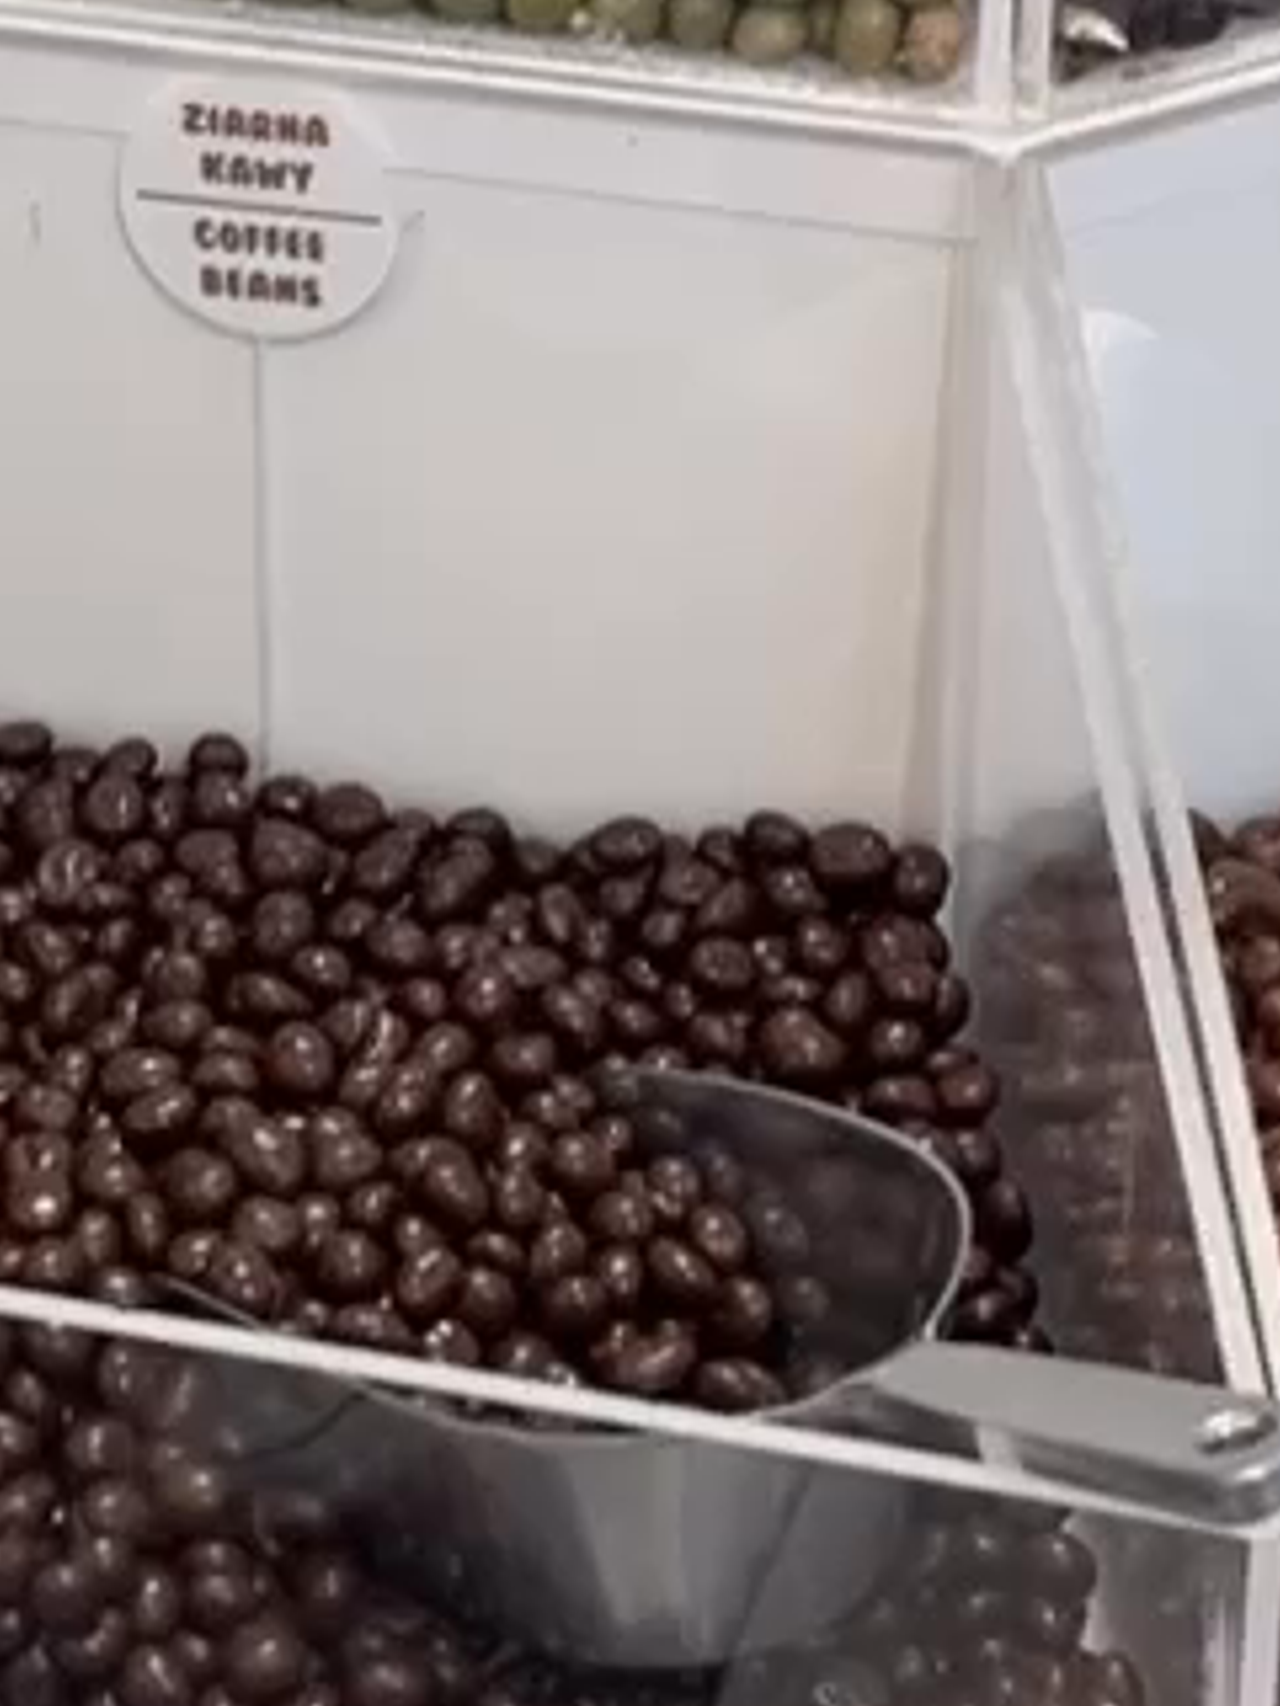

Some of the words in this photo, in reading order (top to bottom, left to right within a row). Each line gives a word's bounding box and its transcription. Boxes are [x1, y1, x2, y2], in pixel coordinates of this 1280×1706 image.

[181, 102, 330, 147] ZIARNA
[200, 151, 314, 194] KAWY
[194, 218, 324, 262] COFFEE
[200, 265, 322, 308] BEANS
